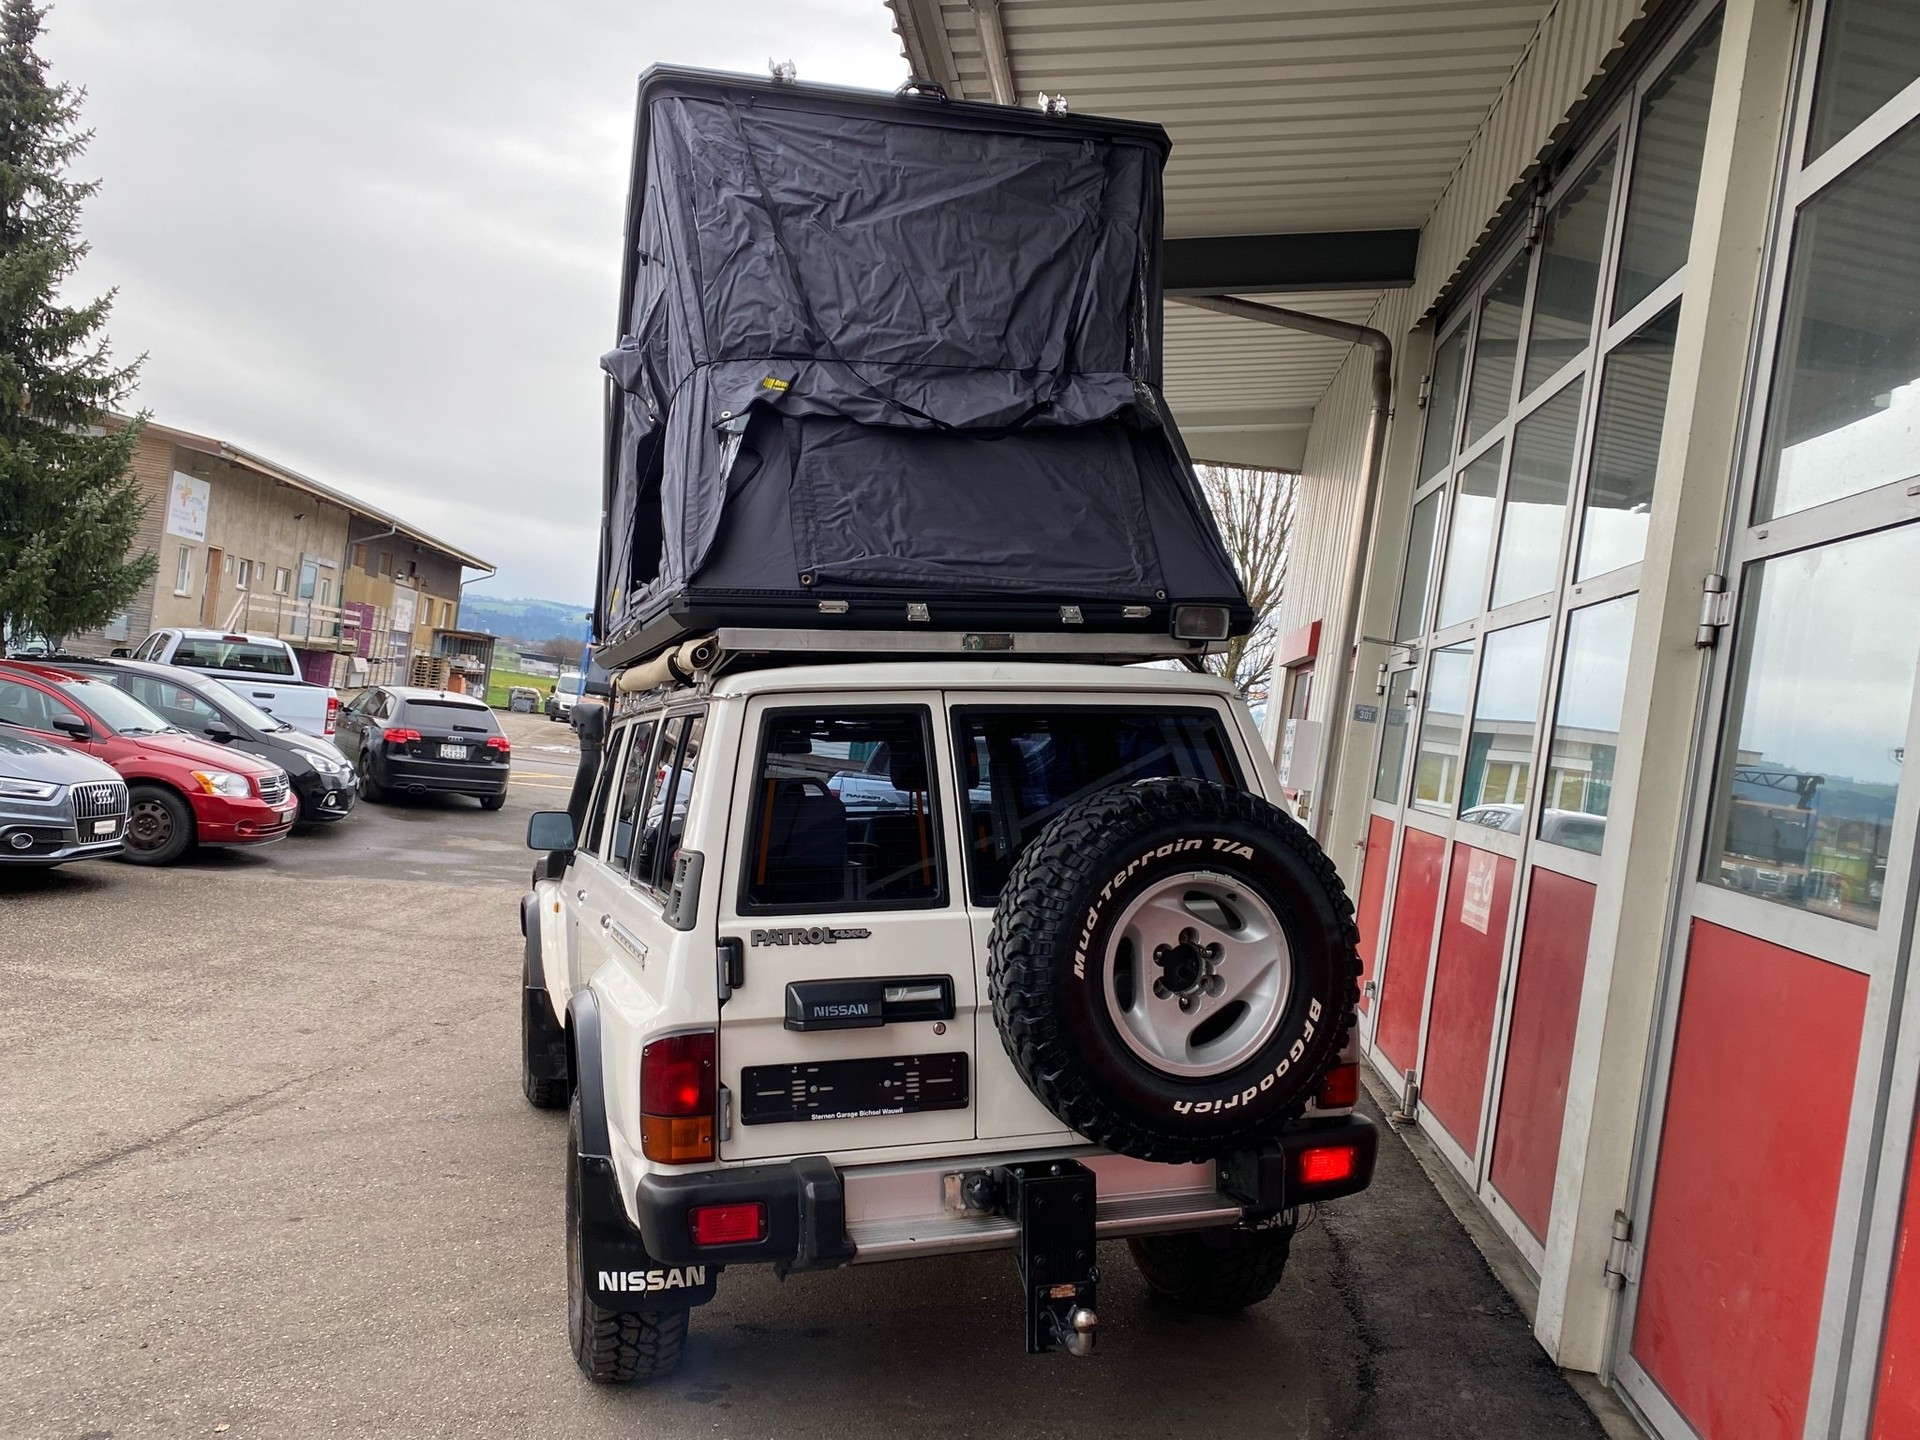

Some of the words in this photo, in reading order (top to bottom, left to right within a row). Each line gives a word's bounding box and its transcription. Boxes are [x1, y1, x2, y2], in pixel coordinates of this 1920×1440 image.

[1358, 710, 1373, 720] 301
[1073, 837, 1203, 980] Mud-Terrain
[1212, 838, 1255, 861] T/A
[750, 926, 838, 947] PATROL
[813, 1003, 869, 1018] NISSAN
[1172, 997, 1323, 1115] BFGoodrich
[859, 1108, 881, 1116] Bichsel
[598, 1265, 706, 1292] NISSAN
